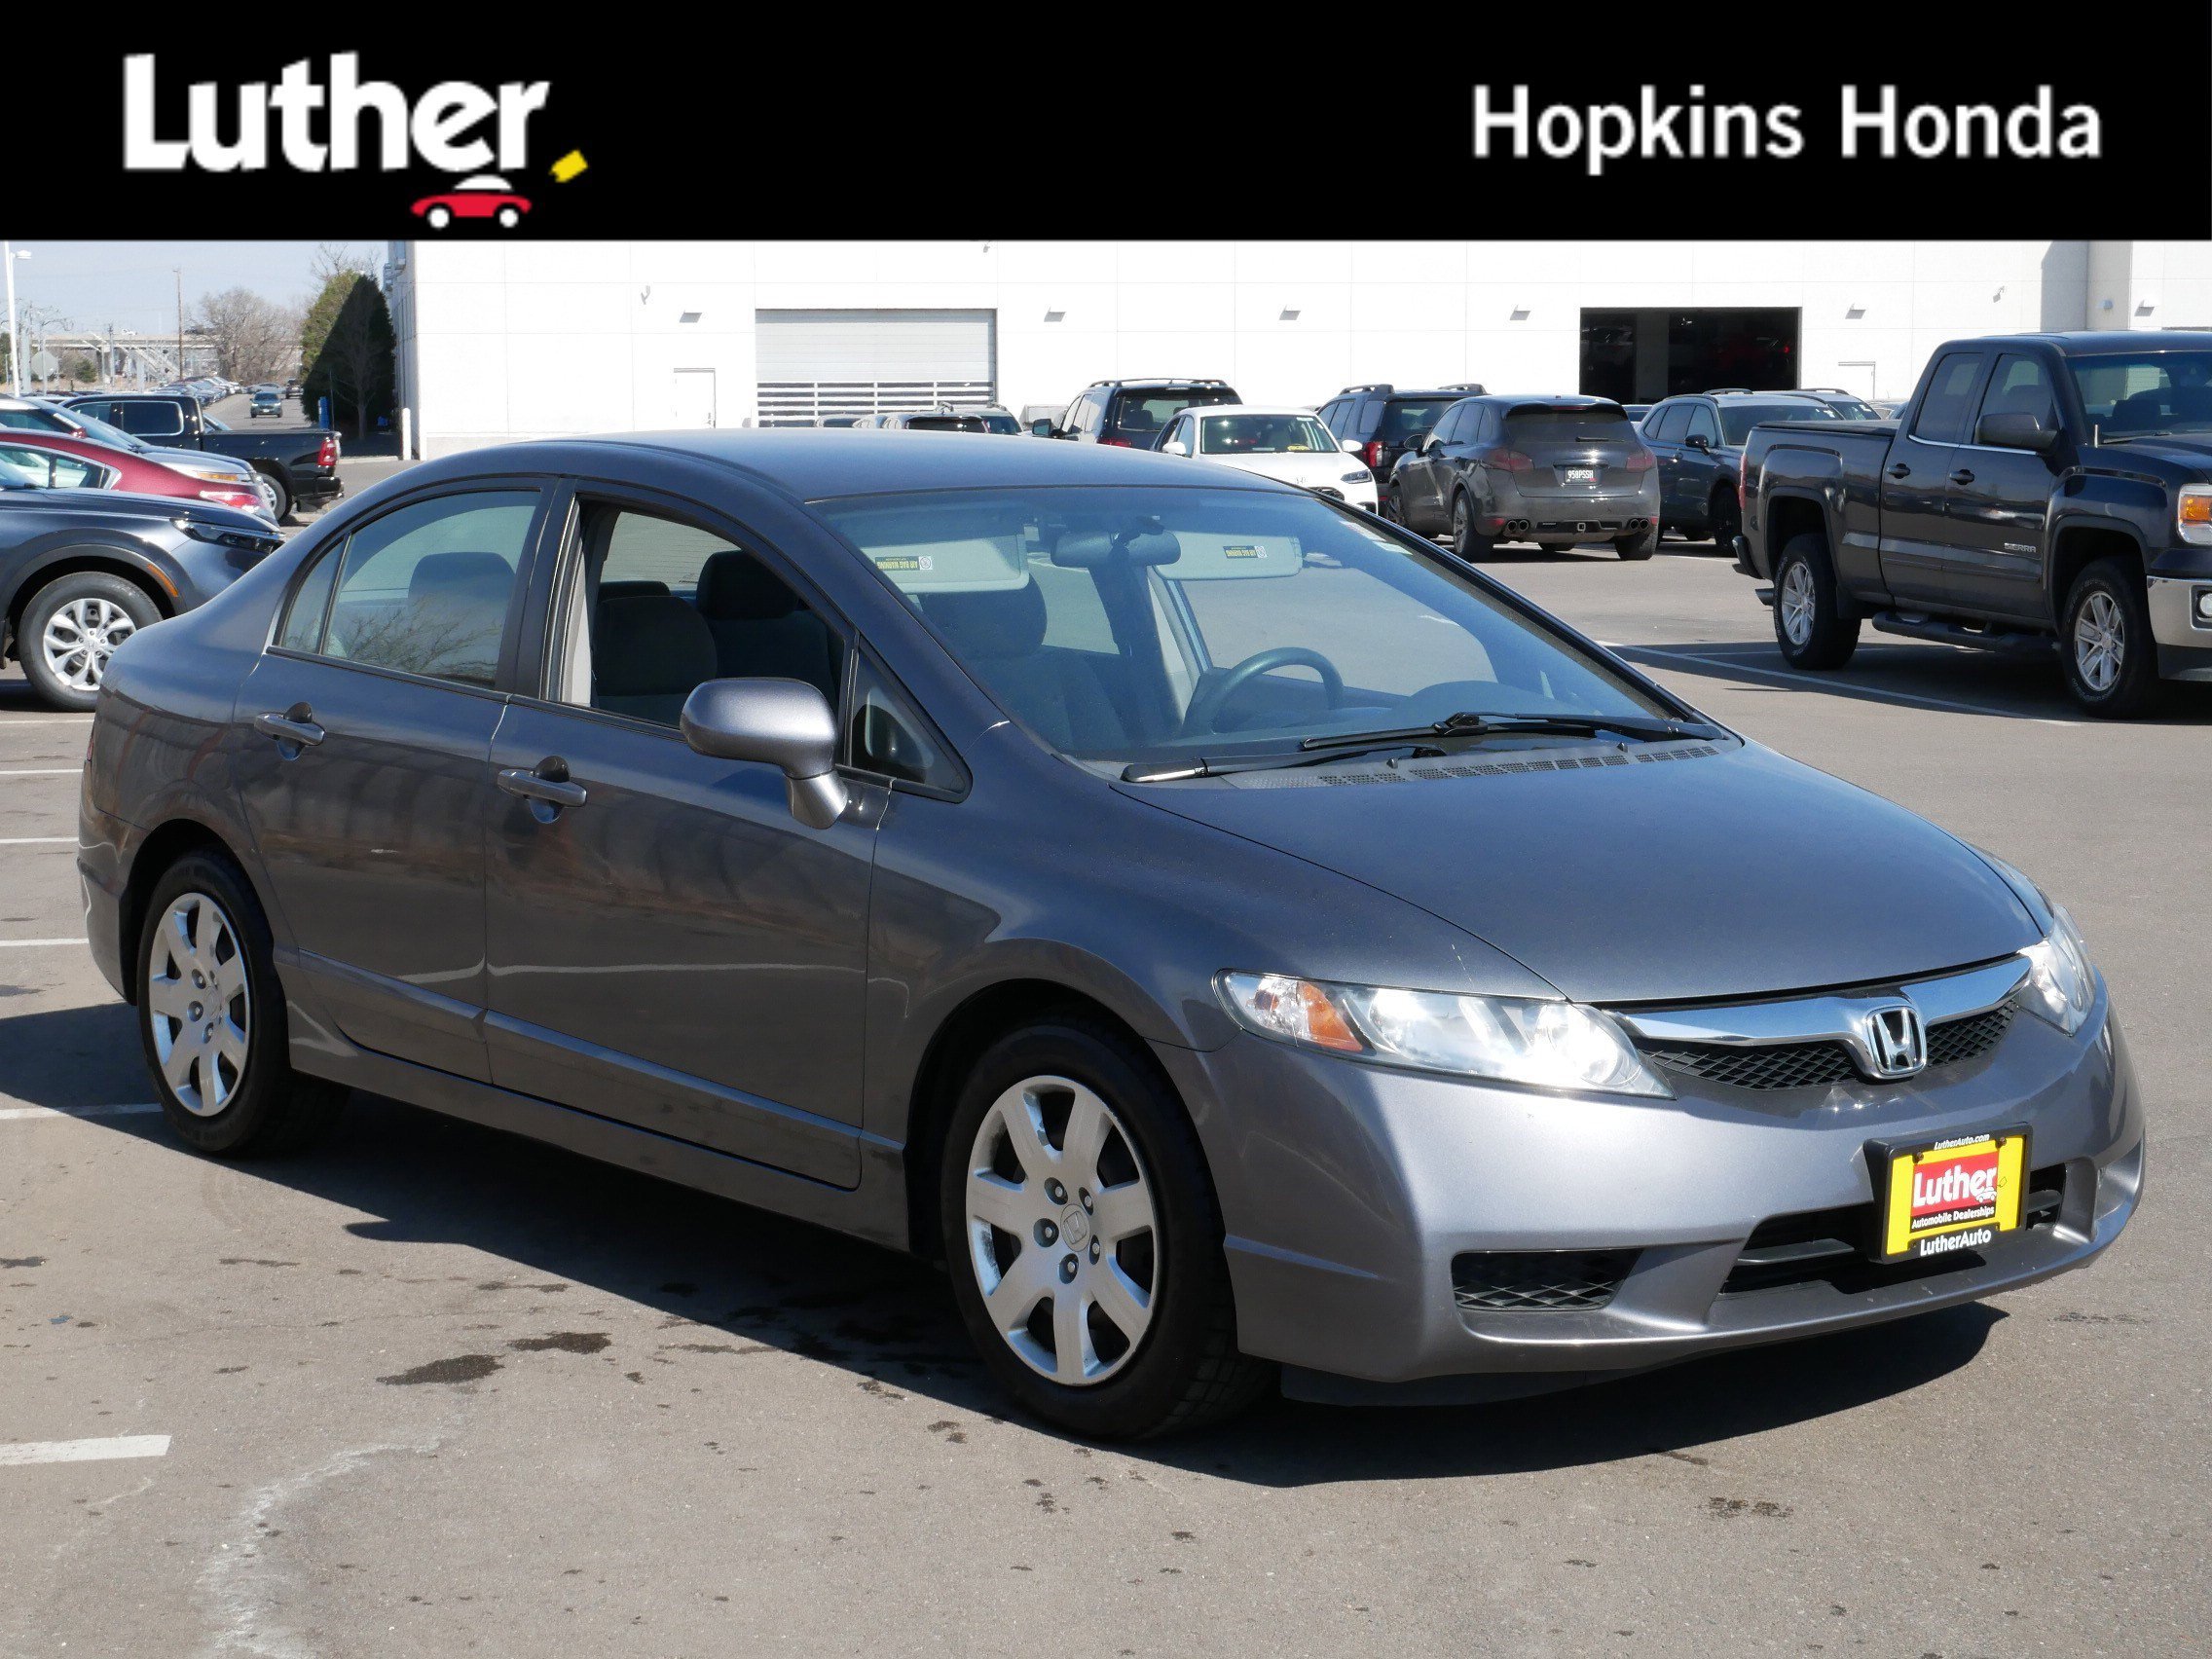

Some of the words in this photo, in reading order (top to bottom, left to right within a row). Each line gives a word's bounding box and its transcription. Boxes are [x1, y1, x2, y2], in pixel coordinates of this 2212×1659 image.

[2004, 542, 2037, 553] SIERRA
[1934, 1133, 1990, 1151] LutherAuto.com
[1912, 1164, 1998, 1208] Luther
[1911, 1212, 1952, 1230] Automobile
[1953, 1205, 1995, 1222] Dealerships
[1920, 1228, 1992, 1257] LutherAuto
